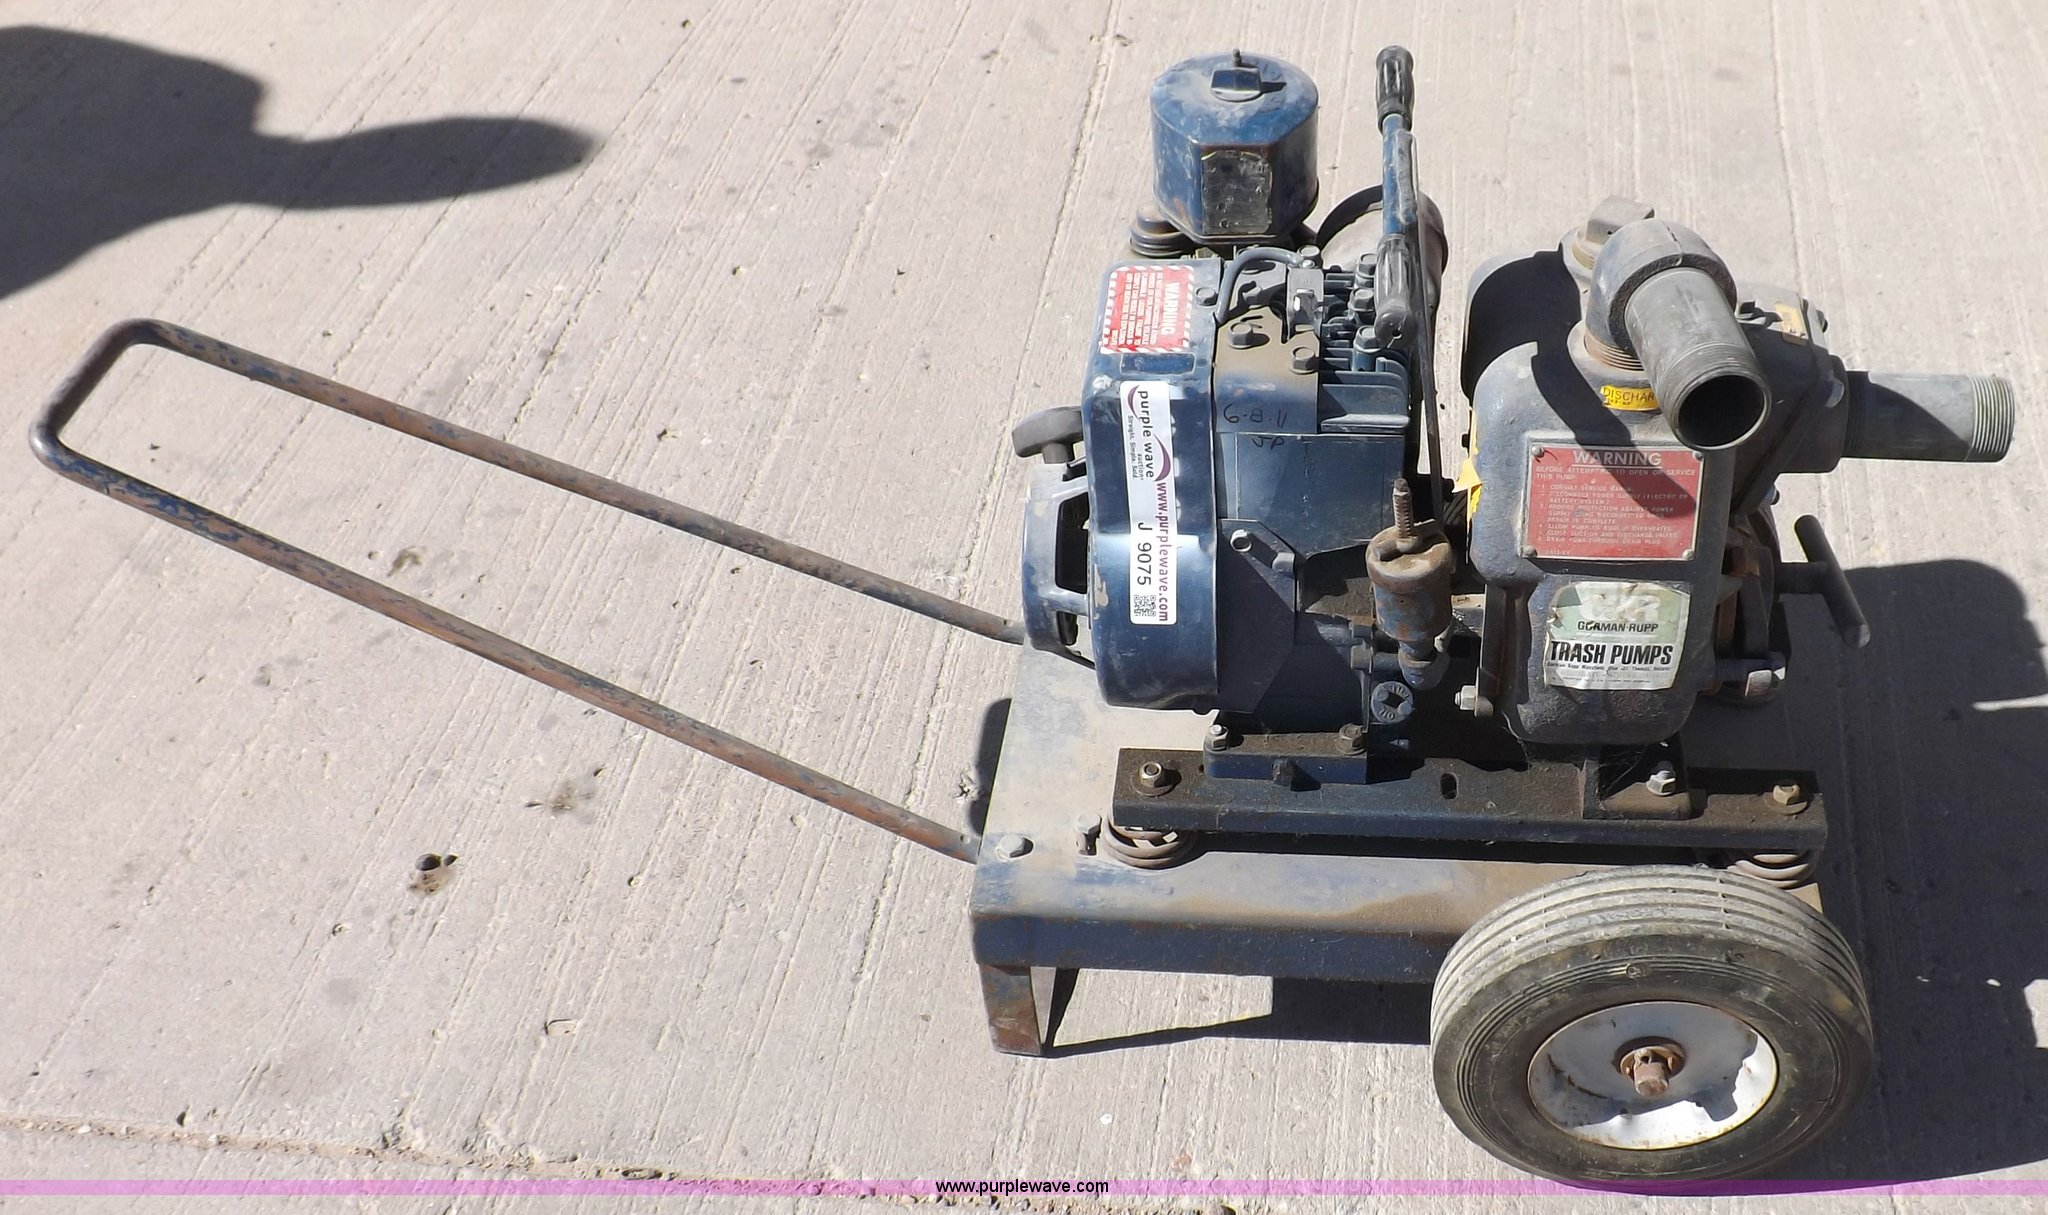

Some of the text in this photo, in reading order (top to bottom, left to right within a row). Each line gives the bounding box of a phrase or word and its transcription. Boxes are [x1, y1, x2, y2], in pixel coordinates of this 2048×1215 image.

[1161, 282, 1179, 335] WARNING
[1604, 387, 1654, 401] DISCHAR
[1137, 390, 1154, 478] purple wave
[1573, 450, 1662, 465] WARNING
[1136, 522, 1153, 586] J 9075
[1155, 482, 1170, 622] www.purplewave.com
[1551, 641, 1674, 666] TRASH PUMPS
